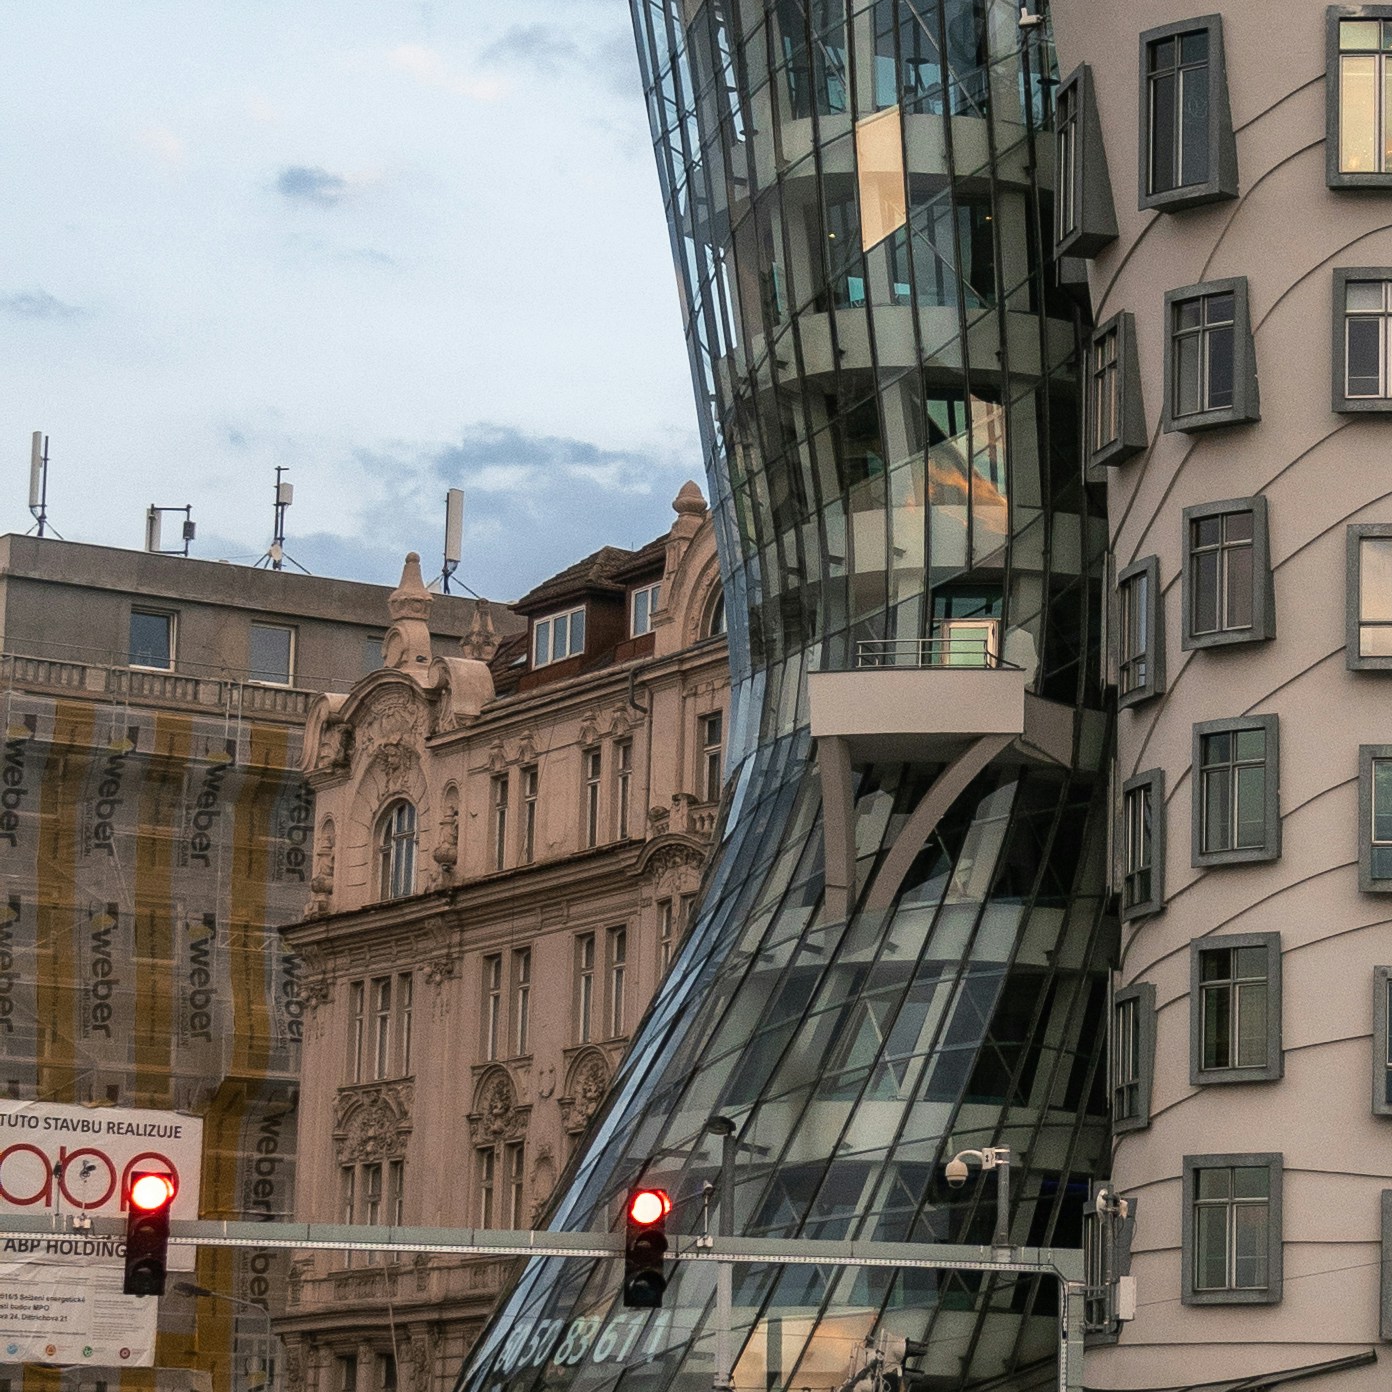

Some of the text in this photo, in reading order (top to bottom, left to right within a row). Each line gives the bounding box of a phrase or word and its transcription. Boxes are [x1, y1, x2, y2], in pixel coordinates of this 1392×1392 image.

[94, 752, 128, 857] weber
[190, 763, 226, 868] weber
[91, 928, 120, 1039] weber
[189, 937, 218, 1043] weber
[0, 1113, 183, 1139] TUTO STAVBU REALIZUJE
[252, 1111, 285, 1213] weber
[4, 1239, 127, 1258] ABP HOLDING
